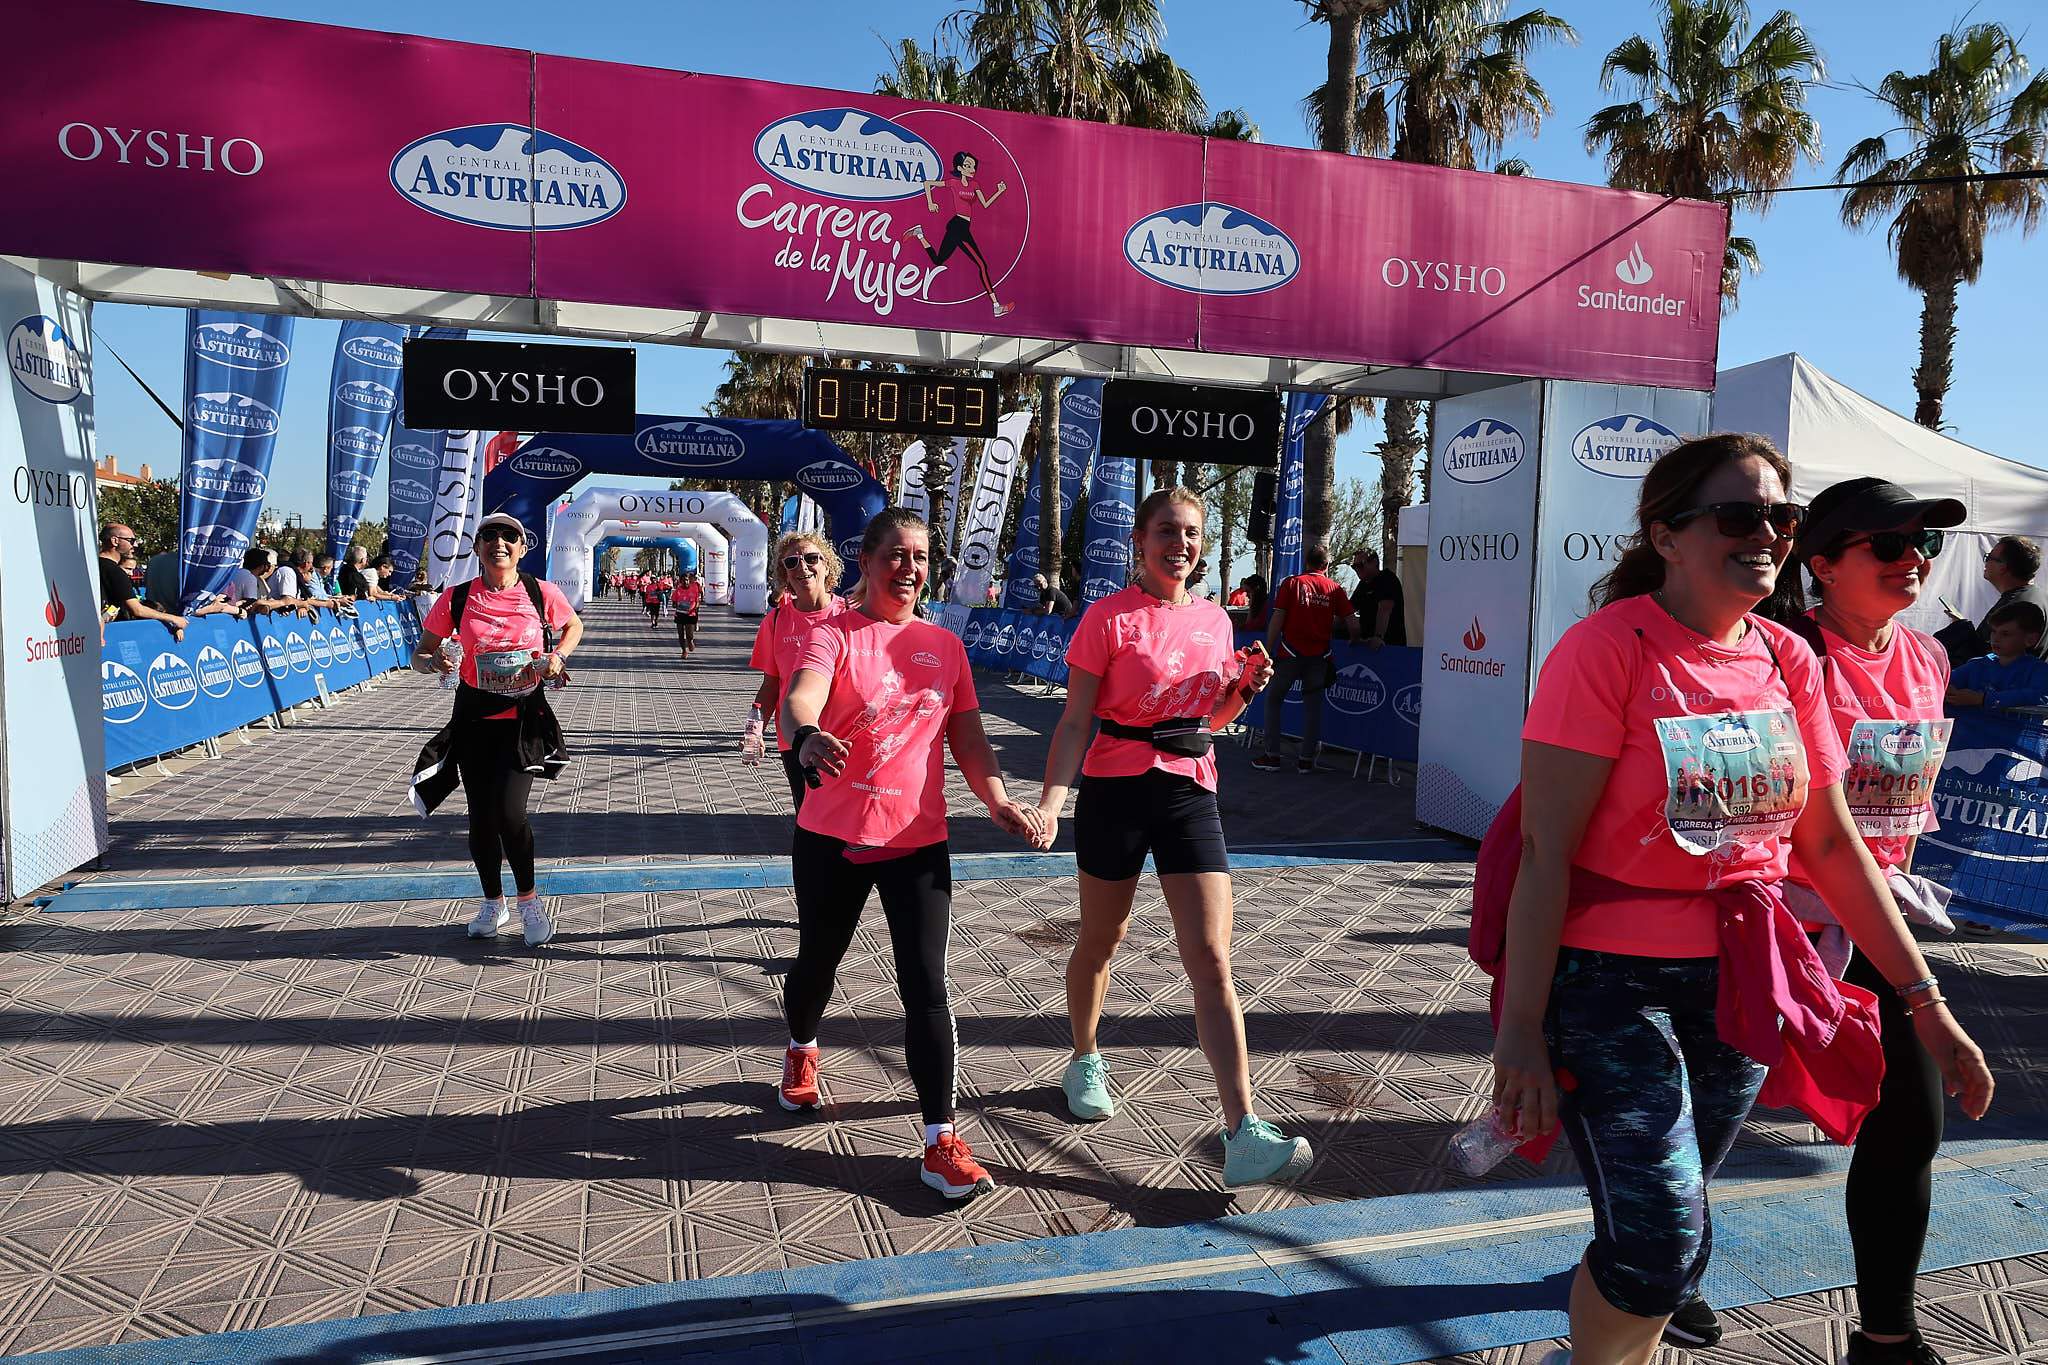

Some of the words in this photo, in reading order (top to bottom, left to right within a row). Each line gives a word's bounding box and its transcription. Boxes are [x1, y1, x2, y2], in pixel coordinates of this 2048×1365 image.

[58, 122, 264, 176] OYSHO
[768, 133, 928, 184] ASTURIANA
[799, 133, 860, 149] CENTRAL
[864, 141, 924, 158] LECHERA
[446, 154, 521, 172] CENTRAL
[408, 154, 610, 210] ASTURIANA
[736, 183, 892, 244] Carrera
[1137, 229, 1287, 277] ASTURIANA
[1166, 230, 1221, 244] CENTRAL
[1226, 236, 1282, 250] LECHERA
[774, 237, 804, 270] de
[810, 238, 831, 273] la
[825, 240, 948, 316] Mujer
[1381, 257, 1507, 297] OYSHO
[1577, 284, 1685, 318] Santander
[195, 332, 282, 364] ASTURIANA
[14, 337, 81, 389] ASTURIANA
[442, 368, 605, 407] OYSHO
[1130, 406, 1256, 442] OYSHO
[643, 433, 738, 458] ASTURIANA
[1447, 445, 1518, 472] ASTURIANA
[514, 456, 576, 473] ASTURIANA
[801, 471, 859, 483] ASTURIANA
[13, 465, 88, 511] OYSHO
[567, 511, 594, 520] OYSHO
[619, 495, 705, 515] OYSHO
[963, 436, 1016, 570] OYSHO
[555, 545, 581, 553] OYSHO
[1440, 532, 1519, 561] OYSHO
[739, 583, 764, 591] OYSHO
[25, 632, 86, 663] Santander
[1440, 653, 1505, 678] Santander
[102, 687, 145, 710] STURIANA
[152, 676, 196, 699] ASTURIANA
[1328, 682, 1378, 706] ASTURIANA
[1880, 773, 1920, 792] 016
[1886, 797, 1906, 805] 4716
[1674, 820, 1713, 830] CARRERA
